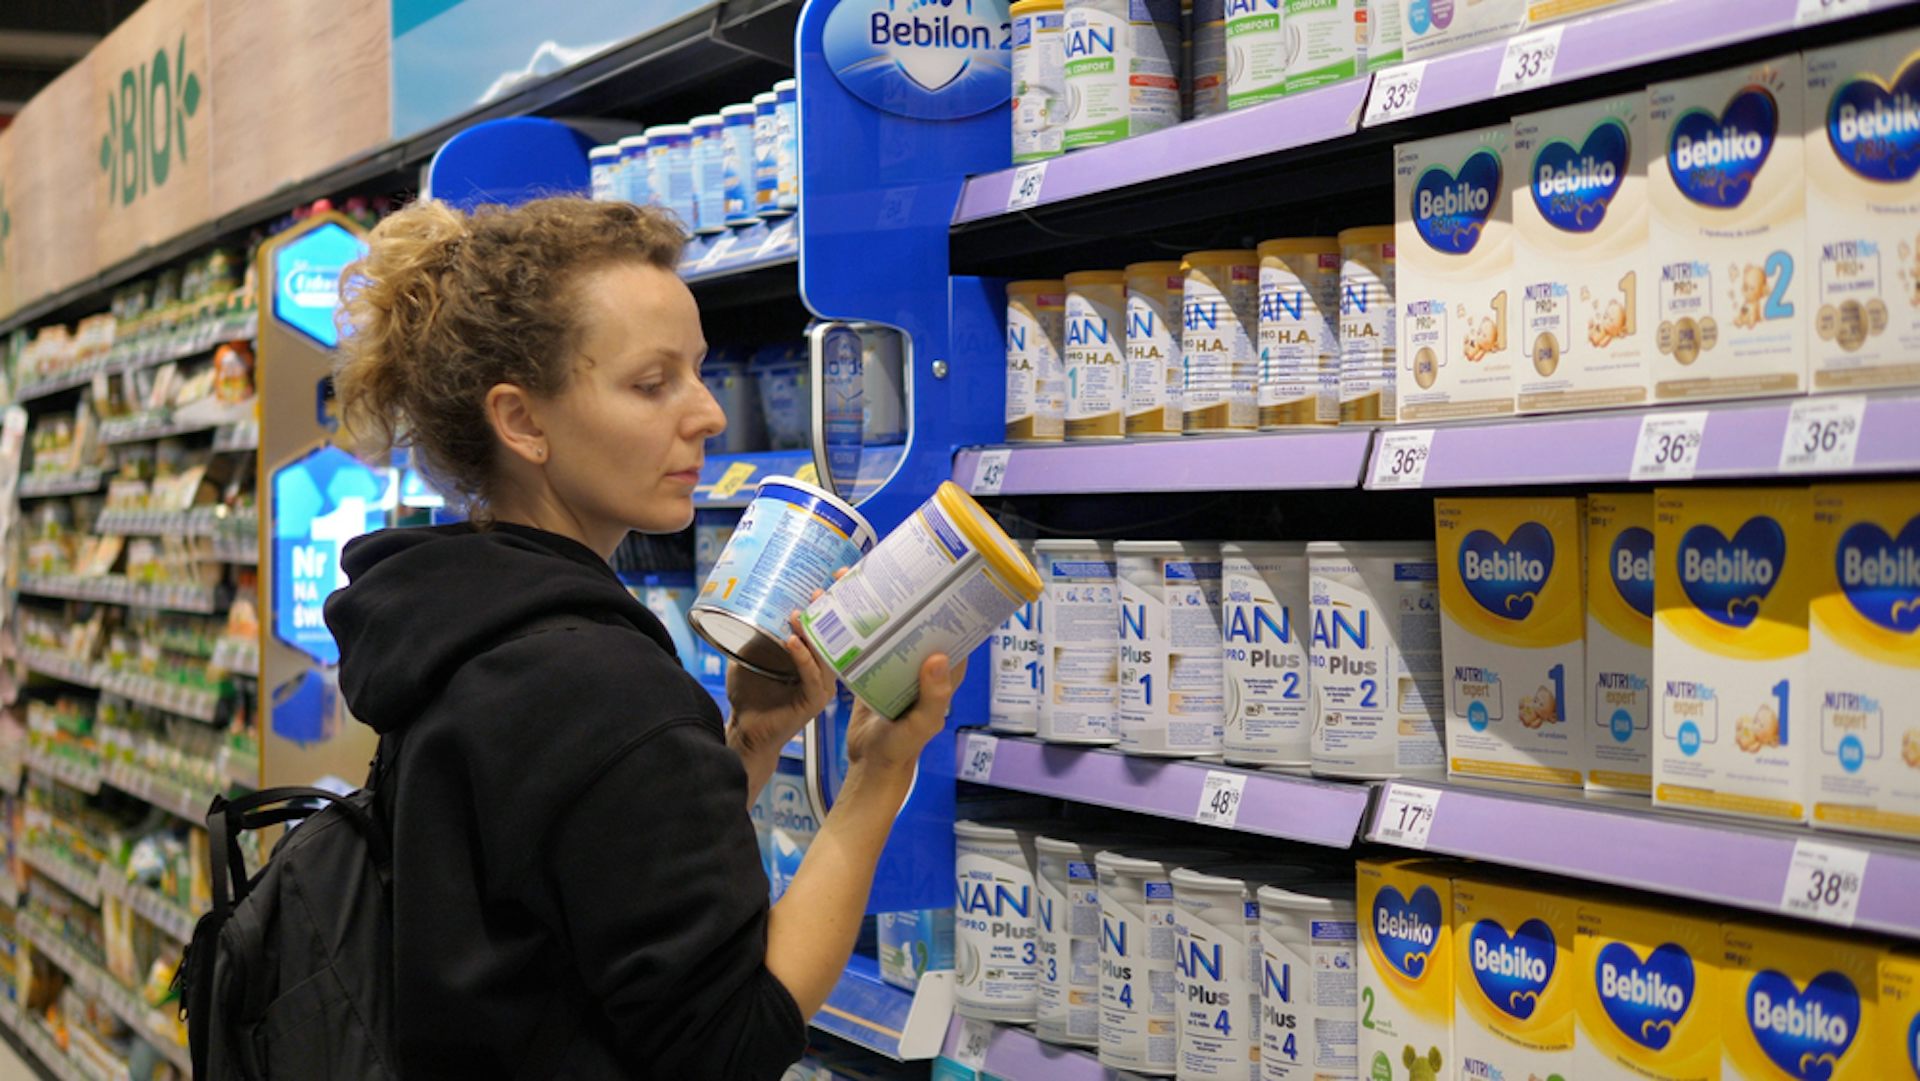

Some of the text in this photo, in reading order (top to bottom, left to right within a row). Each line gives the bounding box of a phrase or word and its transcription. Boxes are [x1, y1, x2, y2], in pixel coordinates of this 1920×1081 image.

[871, 12, 990, 49] Bebilon
[1515, 51, 1542, 80] 33
[1383, 84, 1408, 110] 33
[121, 48, 172, 205] BIO
[1677, 125, 1763, 171] Bebiko
[1539, 156, 1615, 197] Bebiko
[1420, 182, 1489, 219] Bebiko
[1763, 250, 1794, 319] 2
[1260, 291, 1301, 321] AN
[1618, 270, 1636, 336] 1
[1067, 319, 1108, 346] AN
[1490, 289, 1507, 351] 1
[1196, 339, 1228, 352] H.A.
[1278, 330, 1315, 344] H.A.
[1086, 352, 1120, 365] H.A.
[1135, 345, 1164, 359] H.A.
[1067, 367, 1077, 400] 1
[1655, 434, 1686, 464] 36
[1804, 421, 1839, 453] 36
[1391, 448, 1416, 475] 36
[311, 497, 366, 585] 1
[291, 545, 328, 579] Nr
[1465, 550, 1544, 582] Bebiko
[1684, 548, 1773, 584] Bebiko
[292, 580, 319, 602] NA
[722, 577, 738, 600] 1
[1002, 635, 1037, 650] Plus
[1121, 645, 1151, 663] Plus
[1251, 650, 1300, 668] Plus
[1329, 655, 1377, 675] Plus
[1025, 660, 1037, 689] 1
[1139, 673, 1151, 705] 1
[1282, 672, 1300, 699] 2
[1360, 680, 1378, 708] 2
[1462, 683, 1489, 698] expert
[1548, 664, 1565, 722] 1
[1606, 691, 1635, 706] expert
[1673, 701, 1704, 717] expert
[1772, 679, 1789, 746] 1
[1211, 789, 1230, 815] 48
[1399, 804, 1422, 832] 17
[957, 881, 1030, 918] NAN
[1808, 870, 1842, 905] 38
[992, 922, 1036, 939] Plus
[1099, 917, 1127, 957] N
[1377, 907, 1433, 945] Bebiko
[1022, 942, 1036, 965] 3
[1474, 939, 1546, 983] Bebiko
[1047, 958, 1057, 982] 3
[1102, 960, 1132, 980] Plus
[1261, 959, 1291, 1004] N
[1119, 984, 1133, 1009] 4
[1188, 984, 1230, 1006] Plus
[1602, 963, 1684, 1012] Bebiko
[1214, 1009, 1231, 1036] 4
[1263, 1005, 1297, 1029] Plus
[1362, 986, 1375, 1030] 2
[1753, 991, 1848, 1045] Bebiko
[1282, 1033, 1298, 1061] 4
